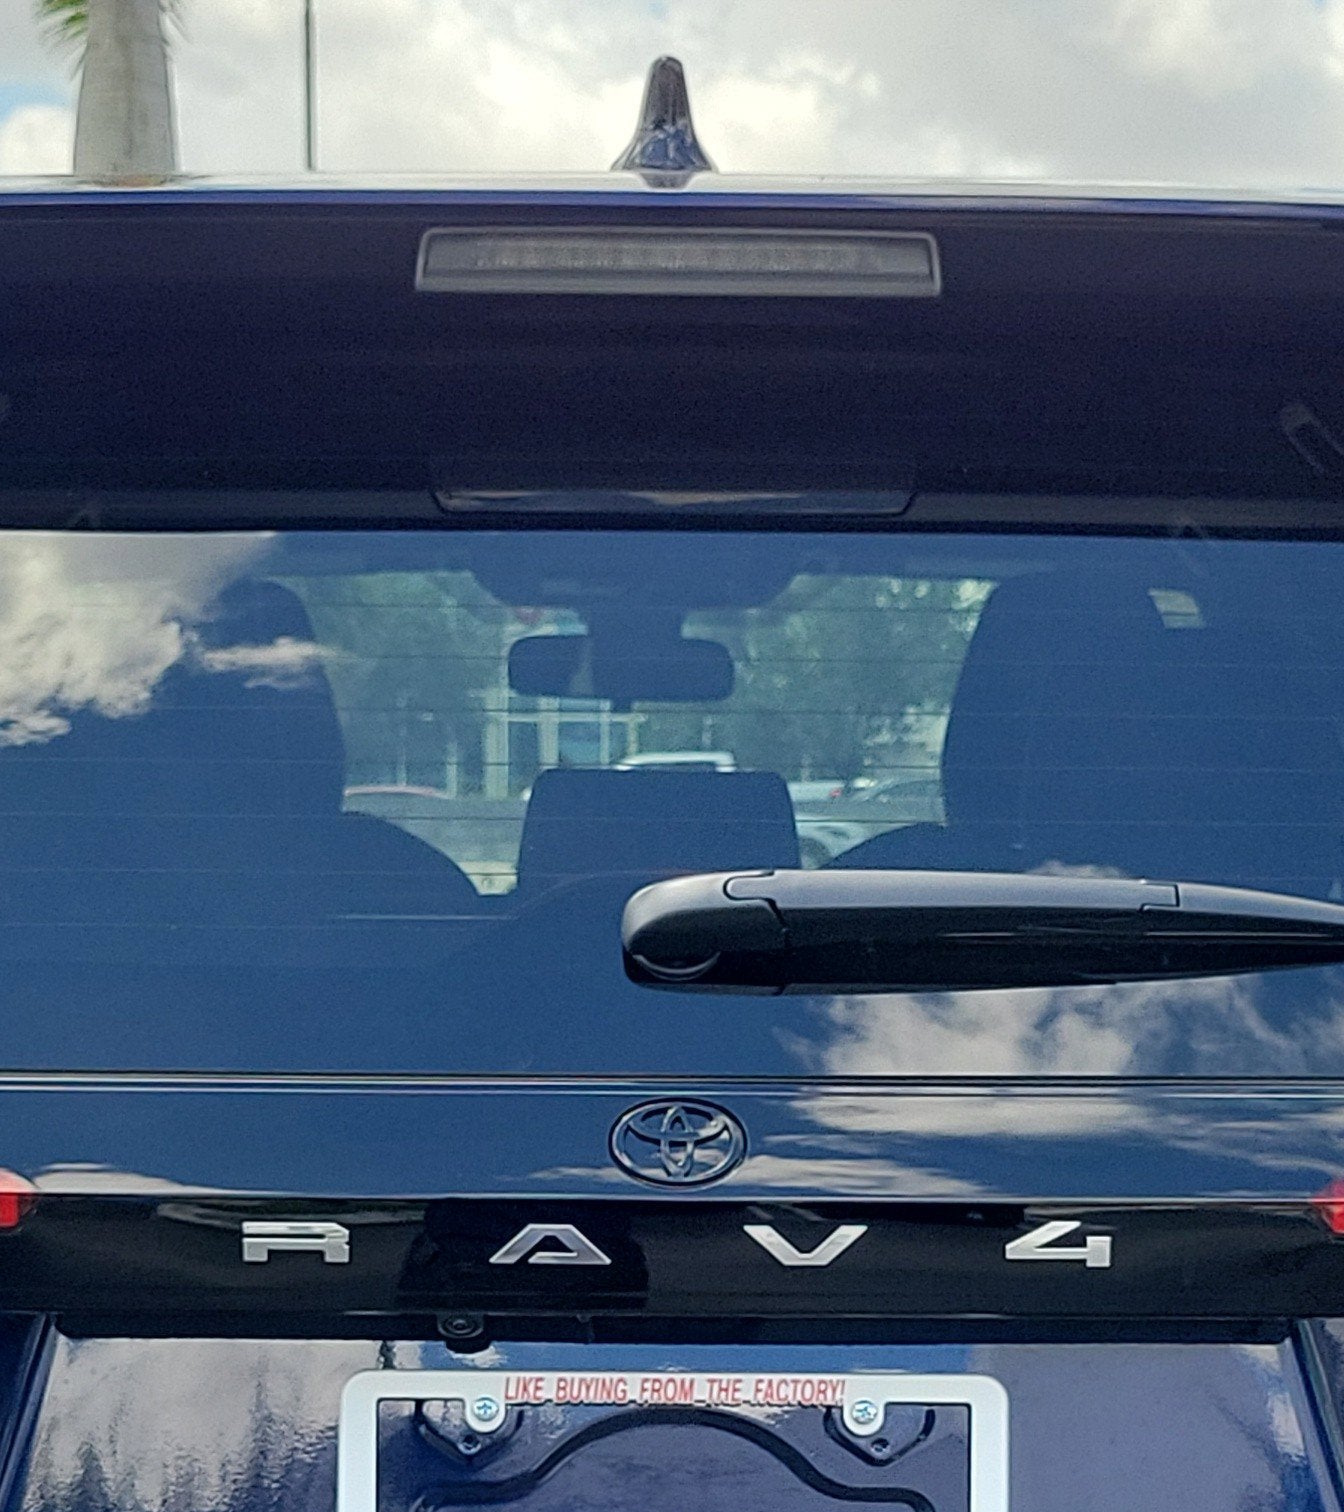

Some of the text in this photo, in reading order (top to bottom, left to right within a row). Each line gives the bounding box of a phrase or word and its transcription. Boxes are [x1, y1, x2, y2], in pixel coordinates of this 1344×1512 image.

[241, 1219, 1113, 1269] RAV4
[505, 1376, 846, 1404] LIKE BUYING FROM THE FACTORY!
